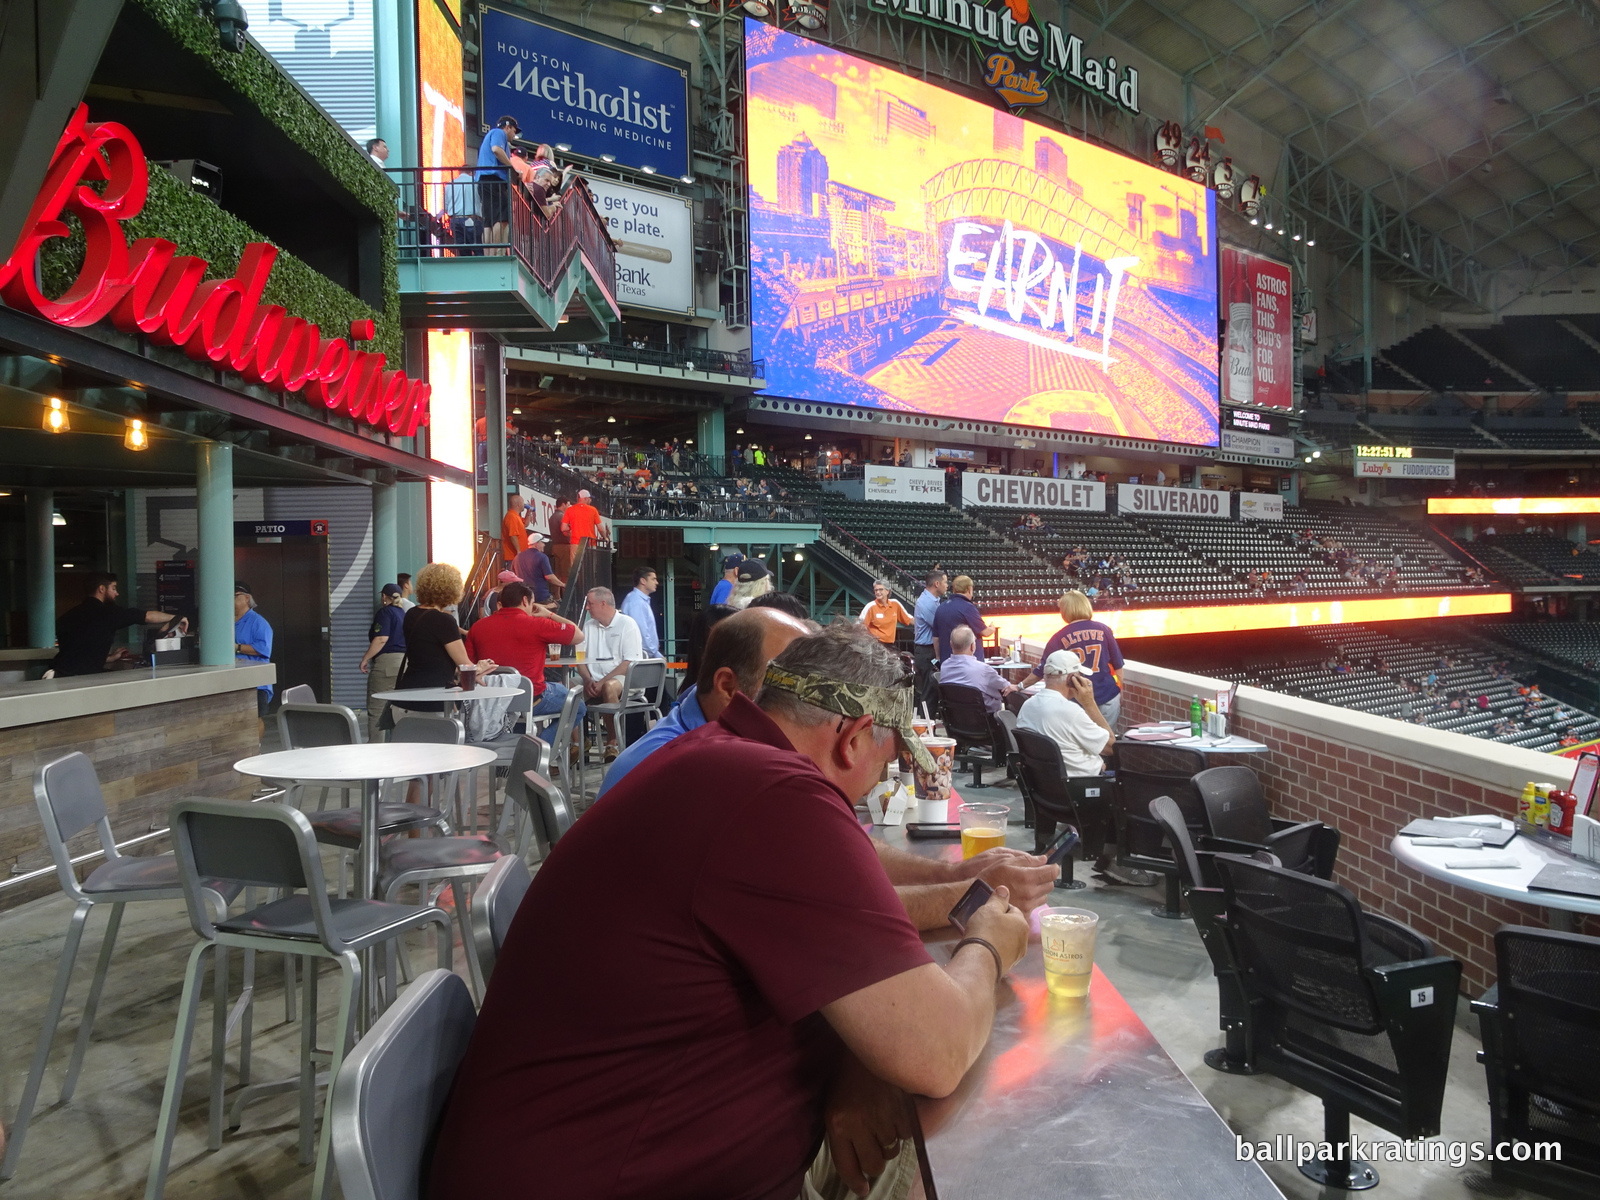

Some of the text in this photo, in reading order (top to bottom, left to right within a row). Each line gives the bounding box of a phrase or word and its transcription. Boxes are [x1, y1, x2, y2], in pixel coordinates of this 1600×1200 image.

[497, 41, 570, 73] HOUSTON
[874, 0, 1140, 113] inute Maid
[985, 53, 1047, 97] Park
[498, 61, 672, 134] Methodist
[551, 109, 672, 150] LEADING MEDICINE
[1162, 120, 1182, 148] 49
[1190, 136, 1210, 162] 24
[1250, 174, 1260, 199] 7
[604, 195, 628, 211] get
[632, 202, 658, 217] you
[624, 218, 664, 238] plate.
[0, 101, 431, 437] Budweiser
[615, 263, 651, 287] Bank
[621, 283, 646, 296] Texas
[1256, 273, 1288, 296] ASTROS
[946, 219, 1140, 373] EARN IT
[1256, 291, 1280, 314] FANS,
[1256, 310, 1275, 330] THIS
[1256, 329, 1282, 349] BUD'S
[1257, 349, 1273, 366] FOR
[1257, 366, 1276, 385] YOU.
[1233, 410, 1254, 420] WELCOME
[1232, 434, 1261, 446] CHAMPION
[1357, 445, 1412, 458] 12:27:51 PM
[1362, 463, 1450, 476] Luby's FUDDRUCKERS
[908, 484, 943, 494] TEXAS
[977, 477, 1094, 508] CHEVROLET
[1133, 488, 1219, 515] SILVERADO
[255, 525, 286, 533] PATIO
[1061, 629, 1105, 649] ALTUVE
[1417, 991, 1426, 1003] 15
